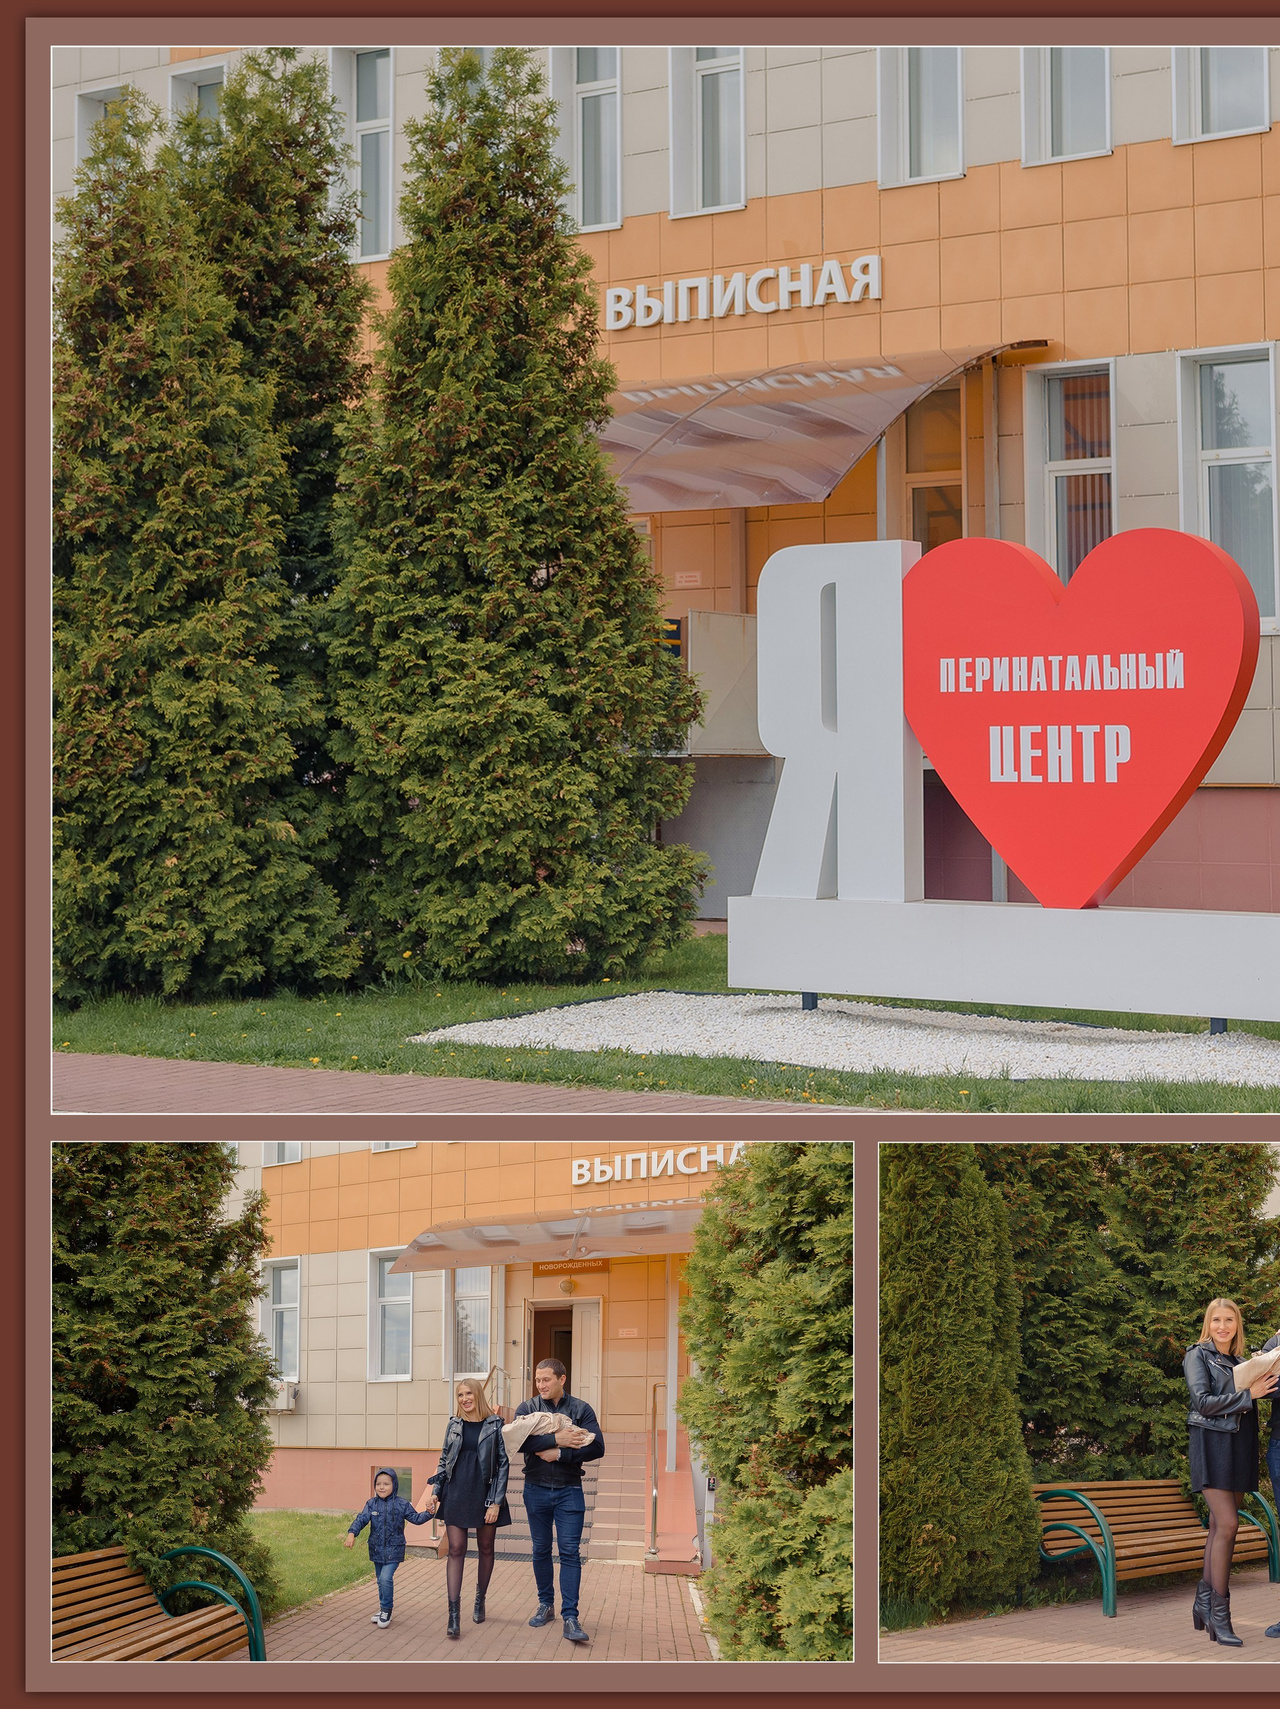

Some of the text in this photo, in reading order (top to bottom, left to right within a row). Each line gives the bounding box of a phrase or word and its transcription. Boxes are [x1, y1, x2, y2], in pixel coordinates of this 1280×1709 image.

[606, 255, 881, 330] ВЫПИСНАЯ
[940, 649, 1185, 692] ПЕРИНАТАЛЬНЫЙ
[751, 539, 908, 902] Я
[989, 725, 1131, 782] ЦЕНТР
[572, 1142, 748, 1186] ВЫПИСНА
[539, 1260, 603, 1271] НОВОРОЖДЕННЫХ
